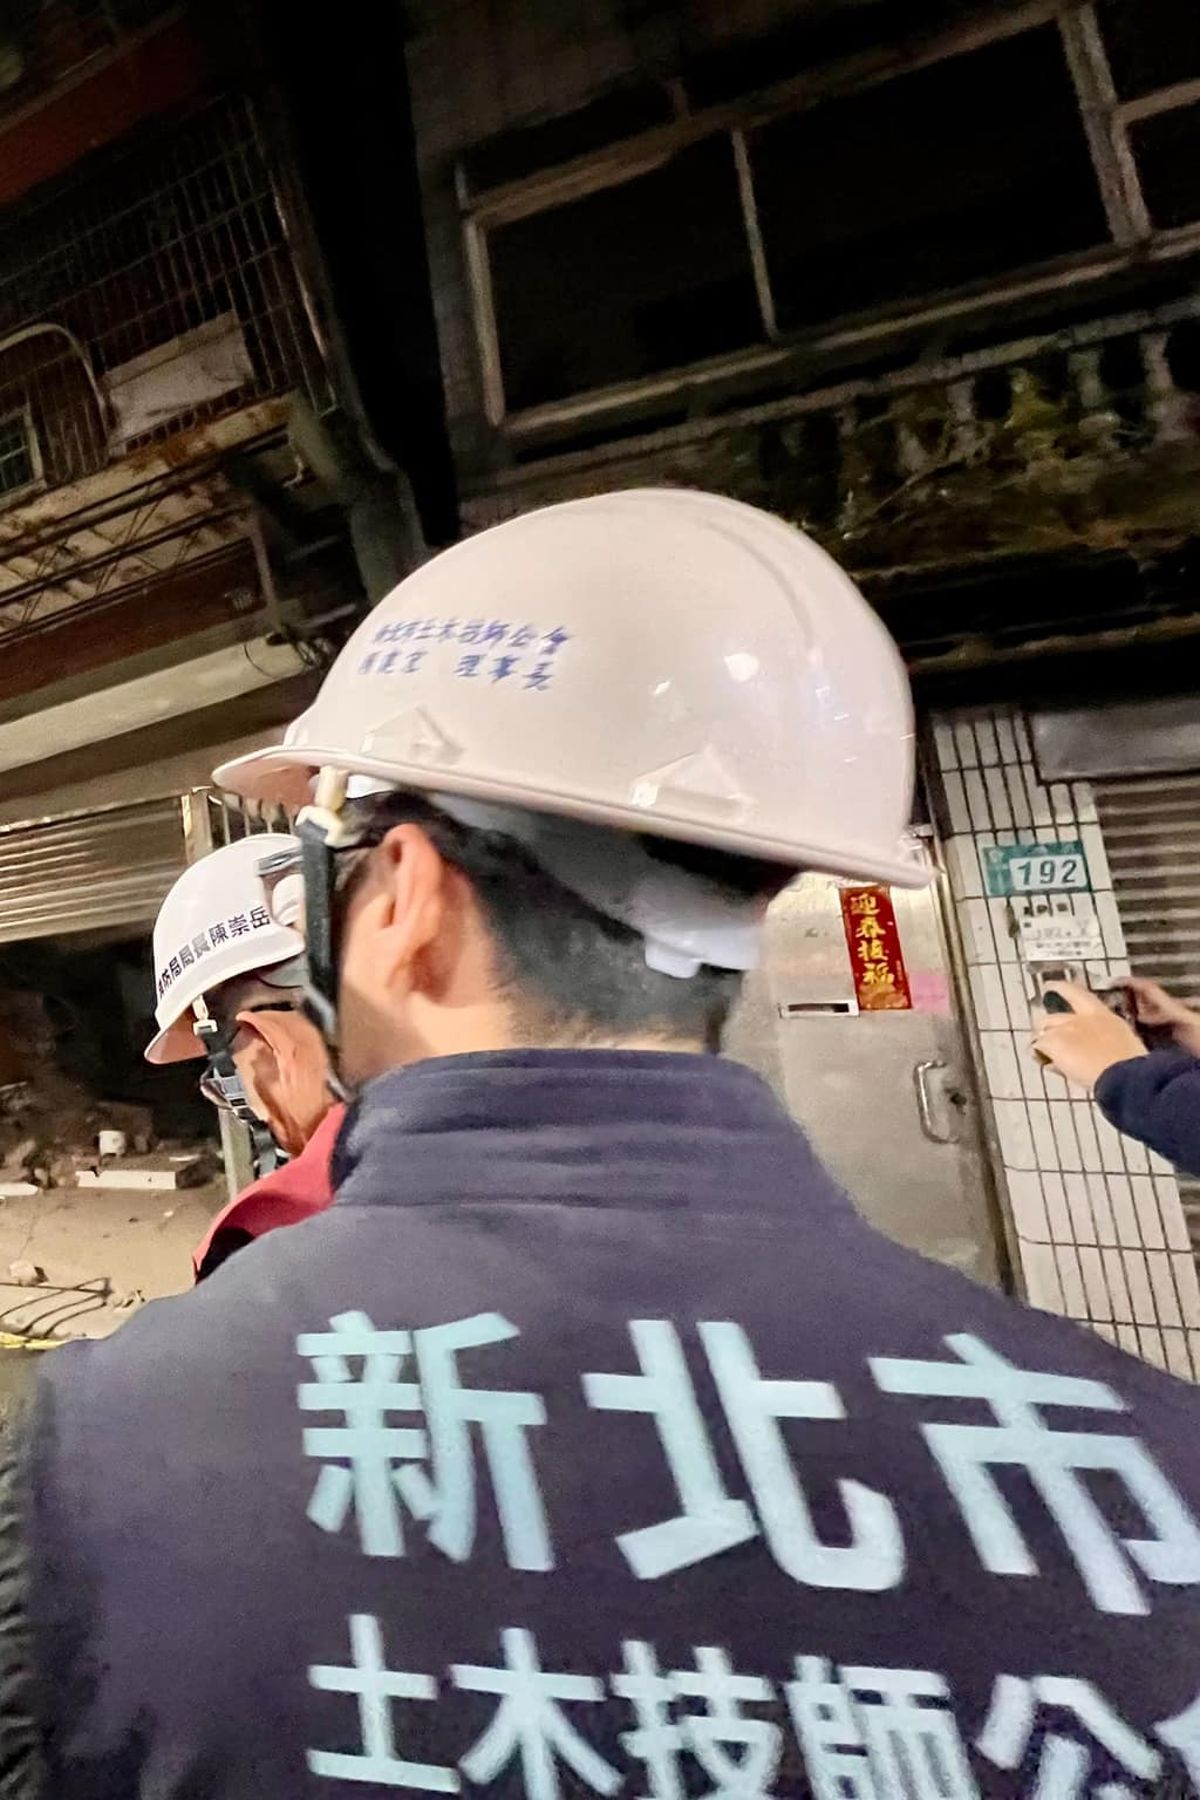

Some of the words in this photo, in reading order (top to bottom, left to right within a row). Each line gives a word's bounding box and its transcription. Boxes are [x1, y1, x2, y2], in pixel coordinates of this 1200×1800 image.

[1017, 859, 1078, 885] 192
[296, 1310, 1200, 1616] 新北市
[305, 1612, 1200, 1800] 土木技師公
